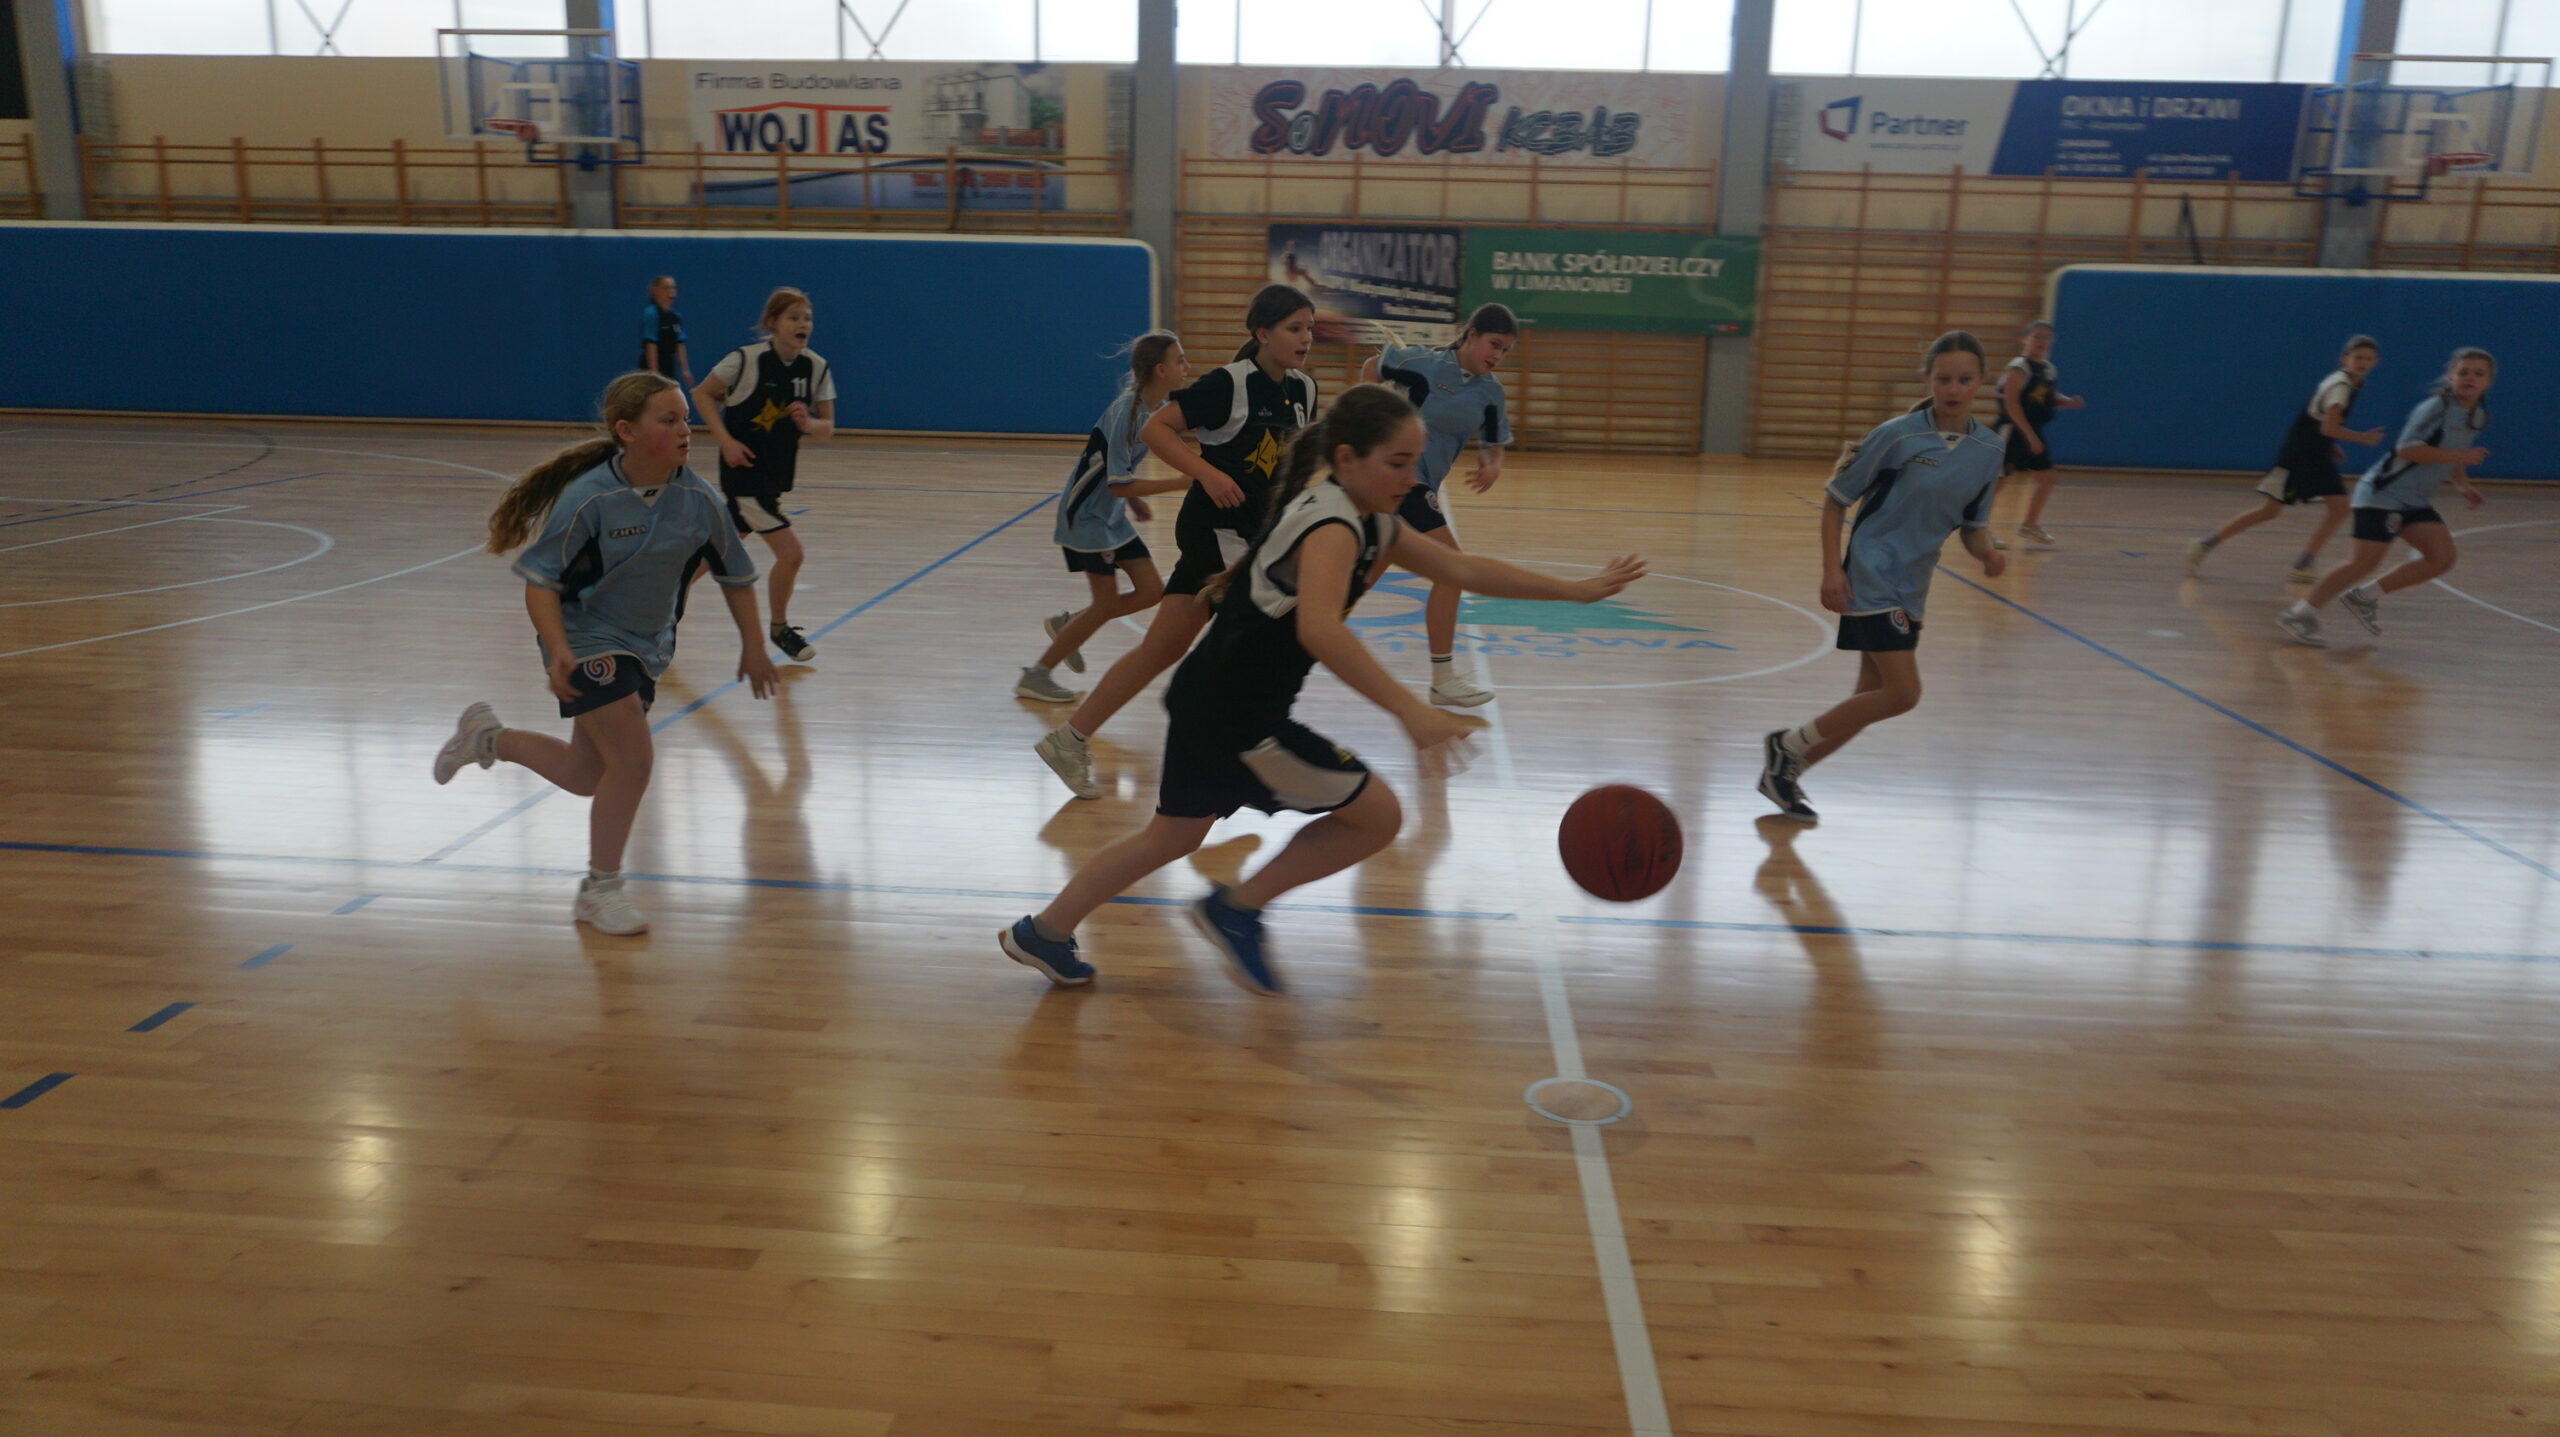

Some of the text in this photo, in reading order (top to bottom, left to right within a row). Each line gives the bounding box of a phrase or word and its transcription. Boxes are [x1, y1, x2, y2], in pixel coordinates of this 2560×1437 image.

[696, 72, 902, 91] Firma Budowlana
[2062, 95, 2136, 117] OKNA
[2153, 97, 2242, 119] DRZWI
[720, 106, 889, 153] WOJTAS
[1870, 111, 1968, 136] Partner
[1492, 249, 1725, 277] BANK SPÓŁDZIELCZY
[1491, 274, 1633, 293] W LIMANOWEJ
[791, 376, 808, 398] 11
[1293, 402, 1306, 429] 6
